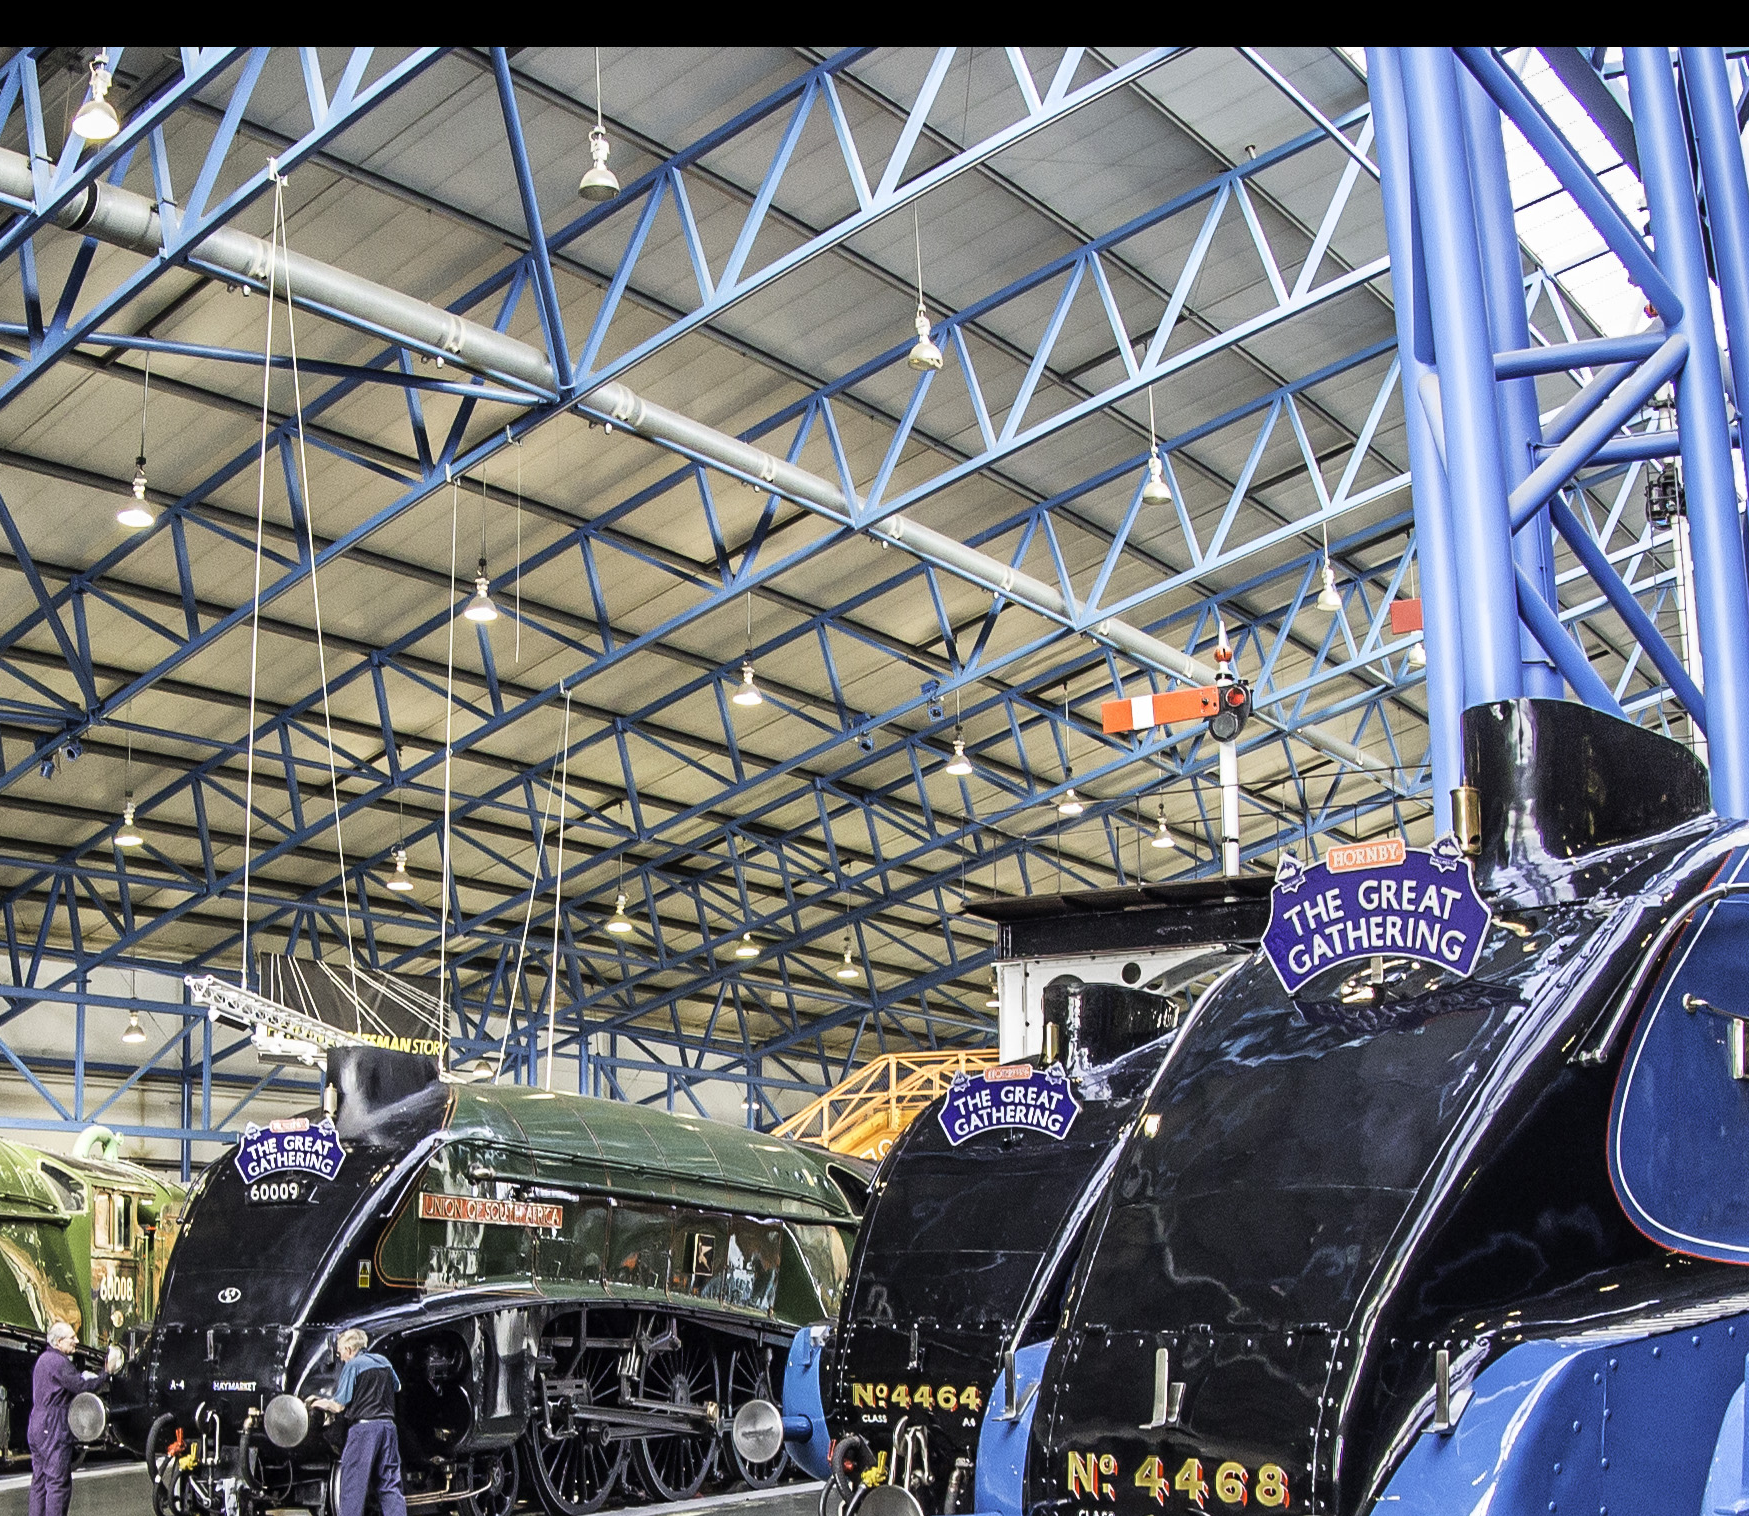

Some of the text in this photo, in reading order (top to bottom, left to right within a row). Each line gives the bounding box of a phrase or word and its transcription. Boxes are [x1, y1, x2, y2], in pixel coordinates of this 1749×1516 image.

[1332, 844, 1399, 868] HORNBY
[1283, 879, 1463, 937] THE GREAT
[1288, 916, 1467, 975] GATHERING
[412, 1039, 449, 1057] STORY
[953, 1086, 1064, 1117] THE GREAT
[953, 1105, 1064, 1136] GATHERING
[247, 1135, 333, 1160] THE GREAT
[247, 1152, 333, 1176] GATHERING
[250, 1182, 299, 1201] 60009
[424, 1195, 463, 1218] UNION
[485, 1202, 523, 1222] SOUTH
[525, 1205, 560, 1226] AFRICA
[100, 1276, 134, 1301] 60008
[212, 1380, 257, 1392] HAYMARKET
[891, 1383, 983, 1412] 4464
[861, 1414, 888, 1424] CLASS
[1134, 1455, 1291, 1510] 4468
